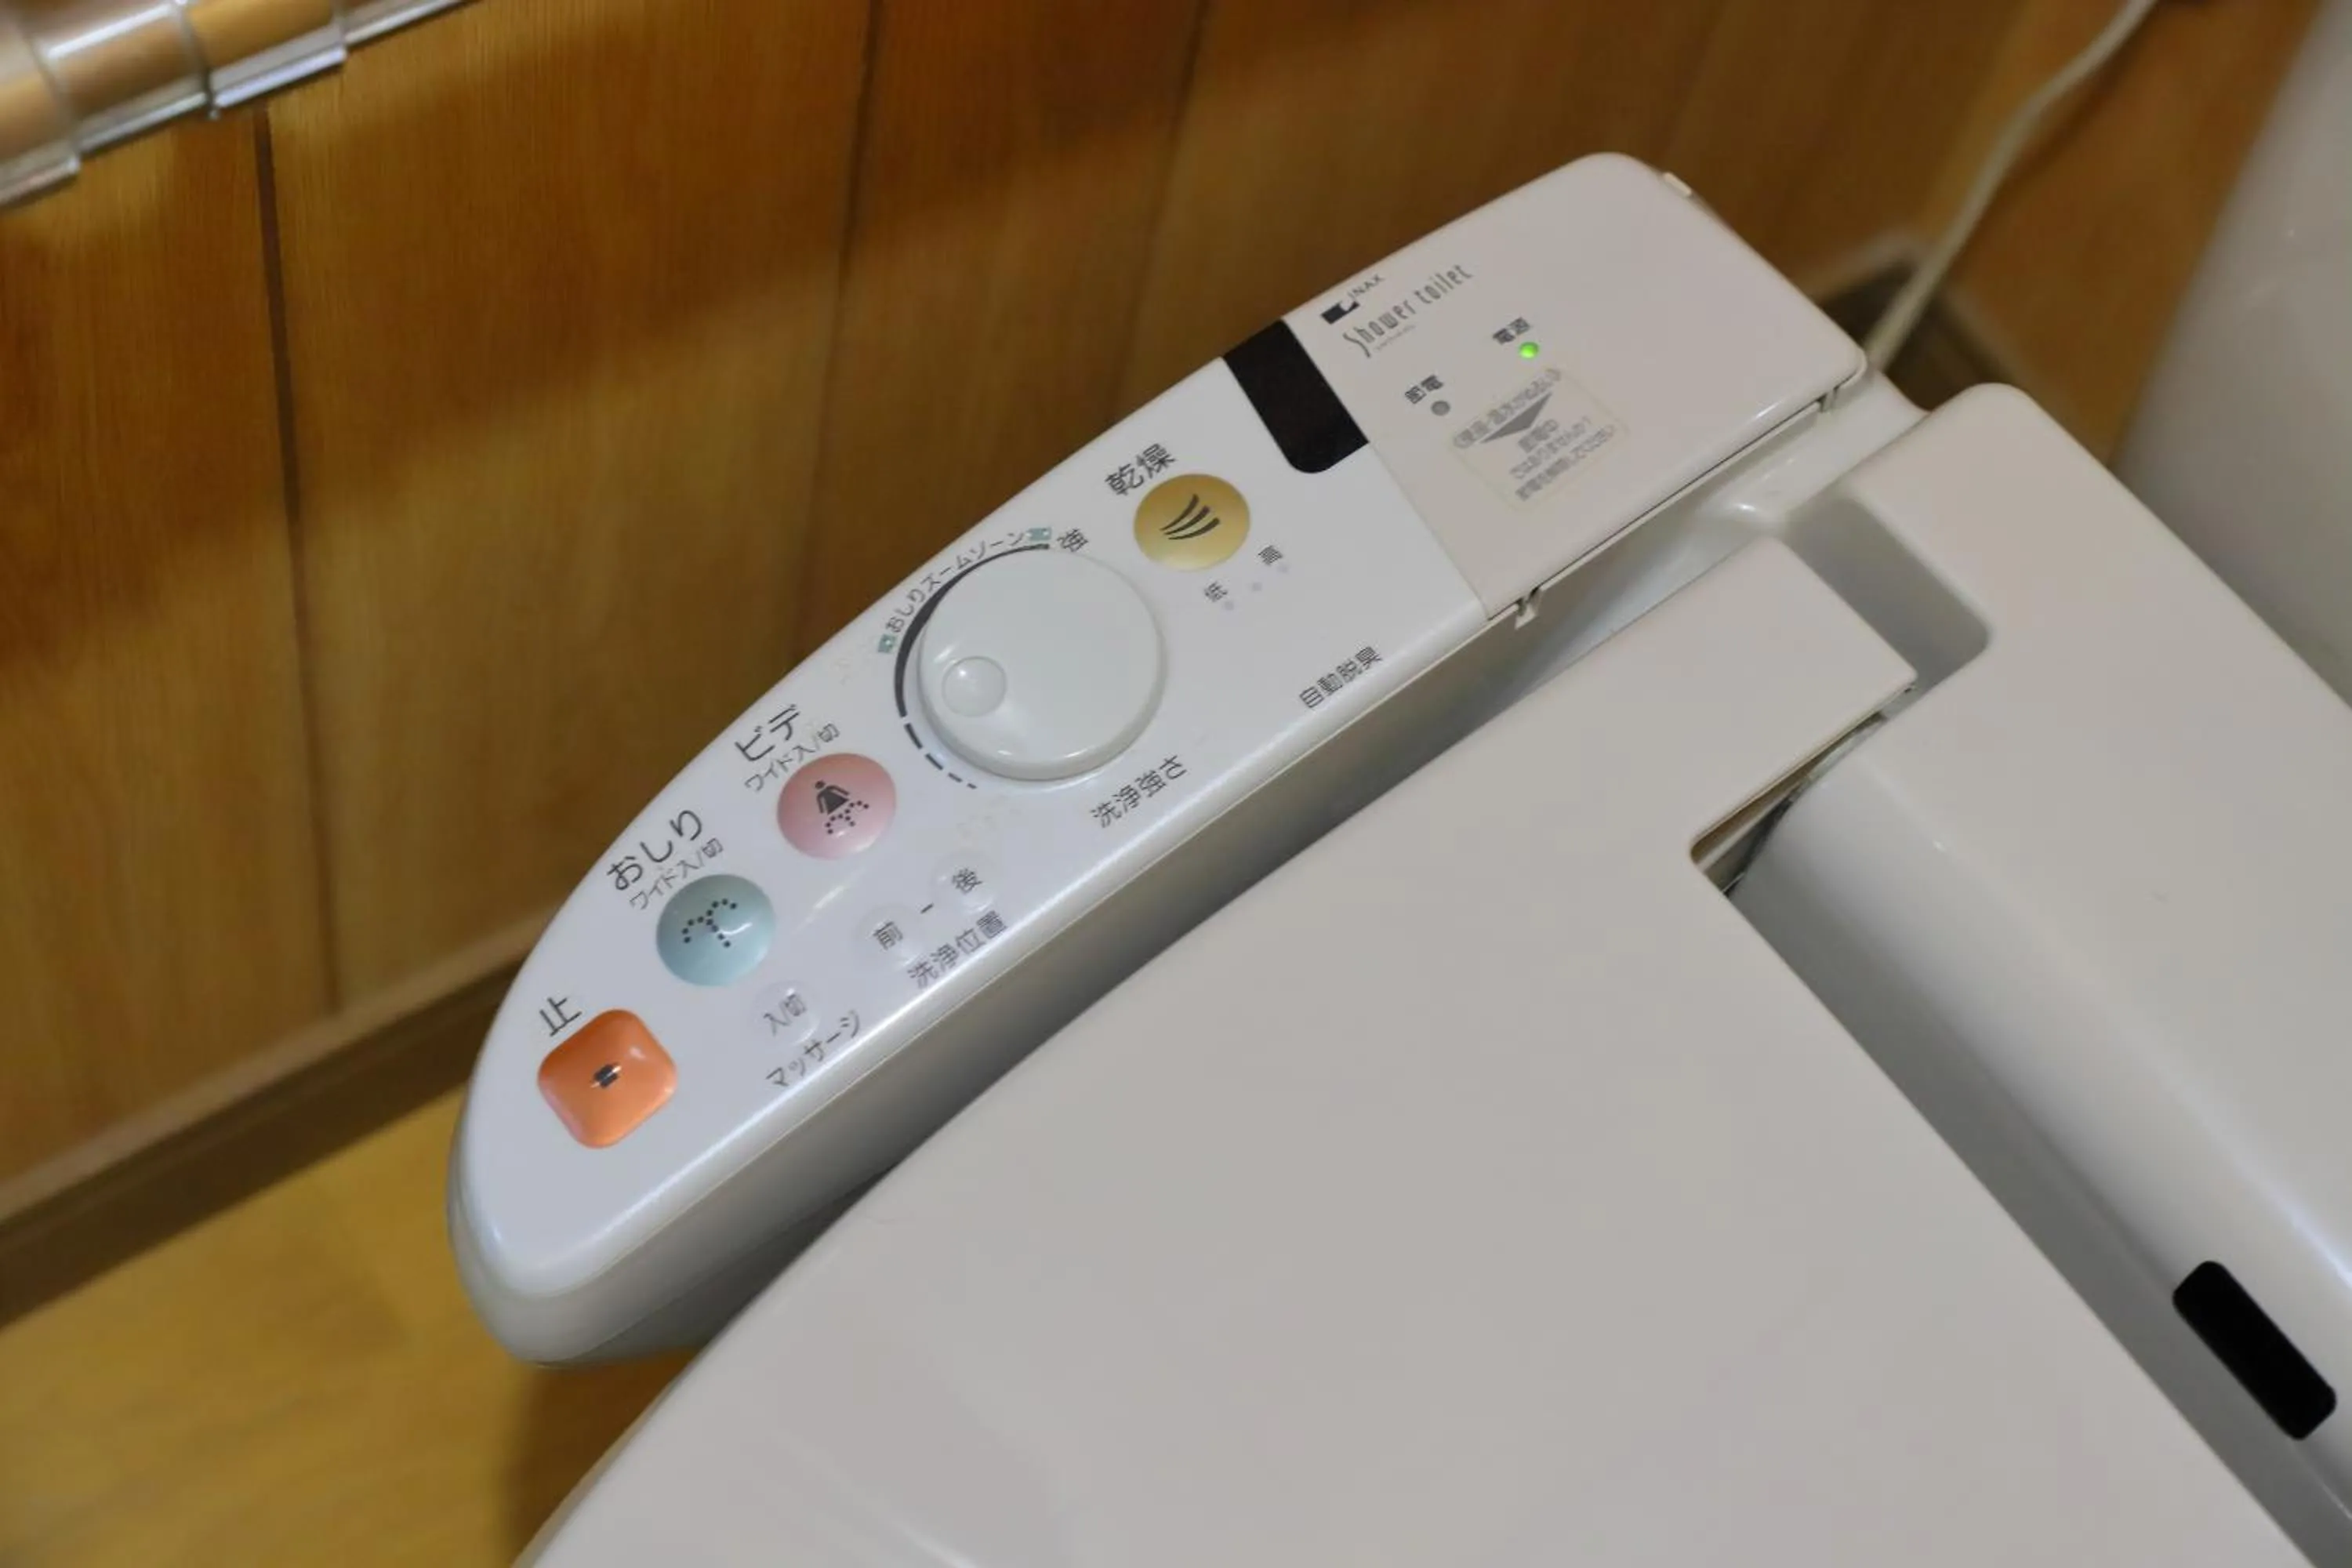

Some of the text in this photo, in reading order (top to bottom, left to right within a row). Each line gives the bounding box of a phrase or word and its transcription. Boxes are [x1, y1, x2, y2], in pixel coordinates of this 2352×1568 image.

[1341, 299, 1416, 358] Shower
[1414, 265, 1472, 304] toilet
[1105, 443, 1177, 496] 乾燥
[1057, 528, 1088, 552] 強
[1298, 646, 1381, 708] 自動脱臭
[735, 703, 800, 761] ビデ
[1091, 755, 1187, 829] 洗浄強さ
[606, 810, 702, 891] おしり
[951, 868, 982, 895] 後
[907, 910, 1007, 989] 洗浄位置
[539, 997, 582, 1036] 止
[766, 1010, 860, 1087] マッサージ
